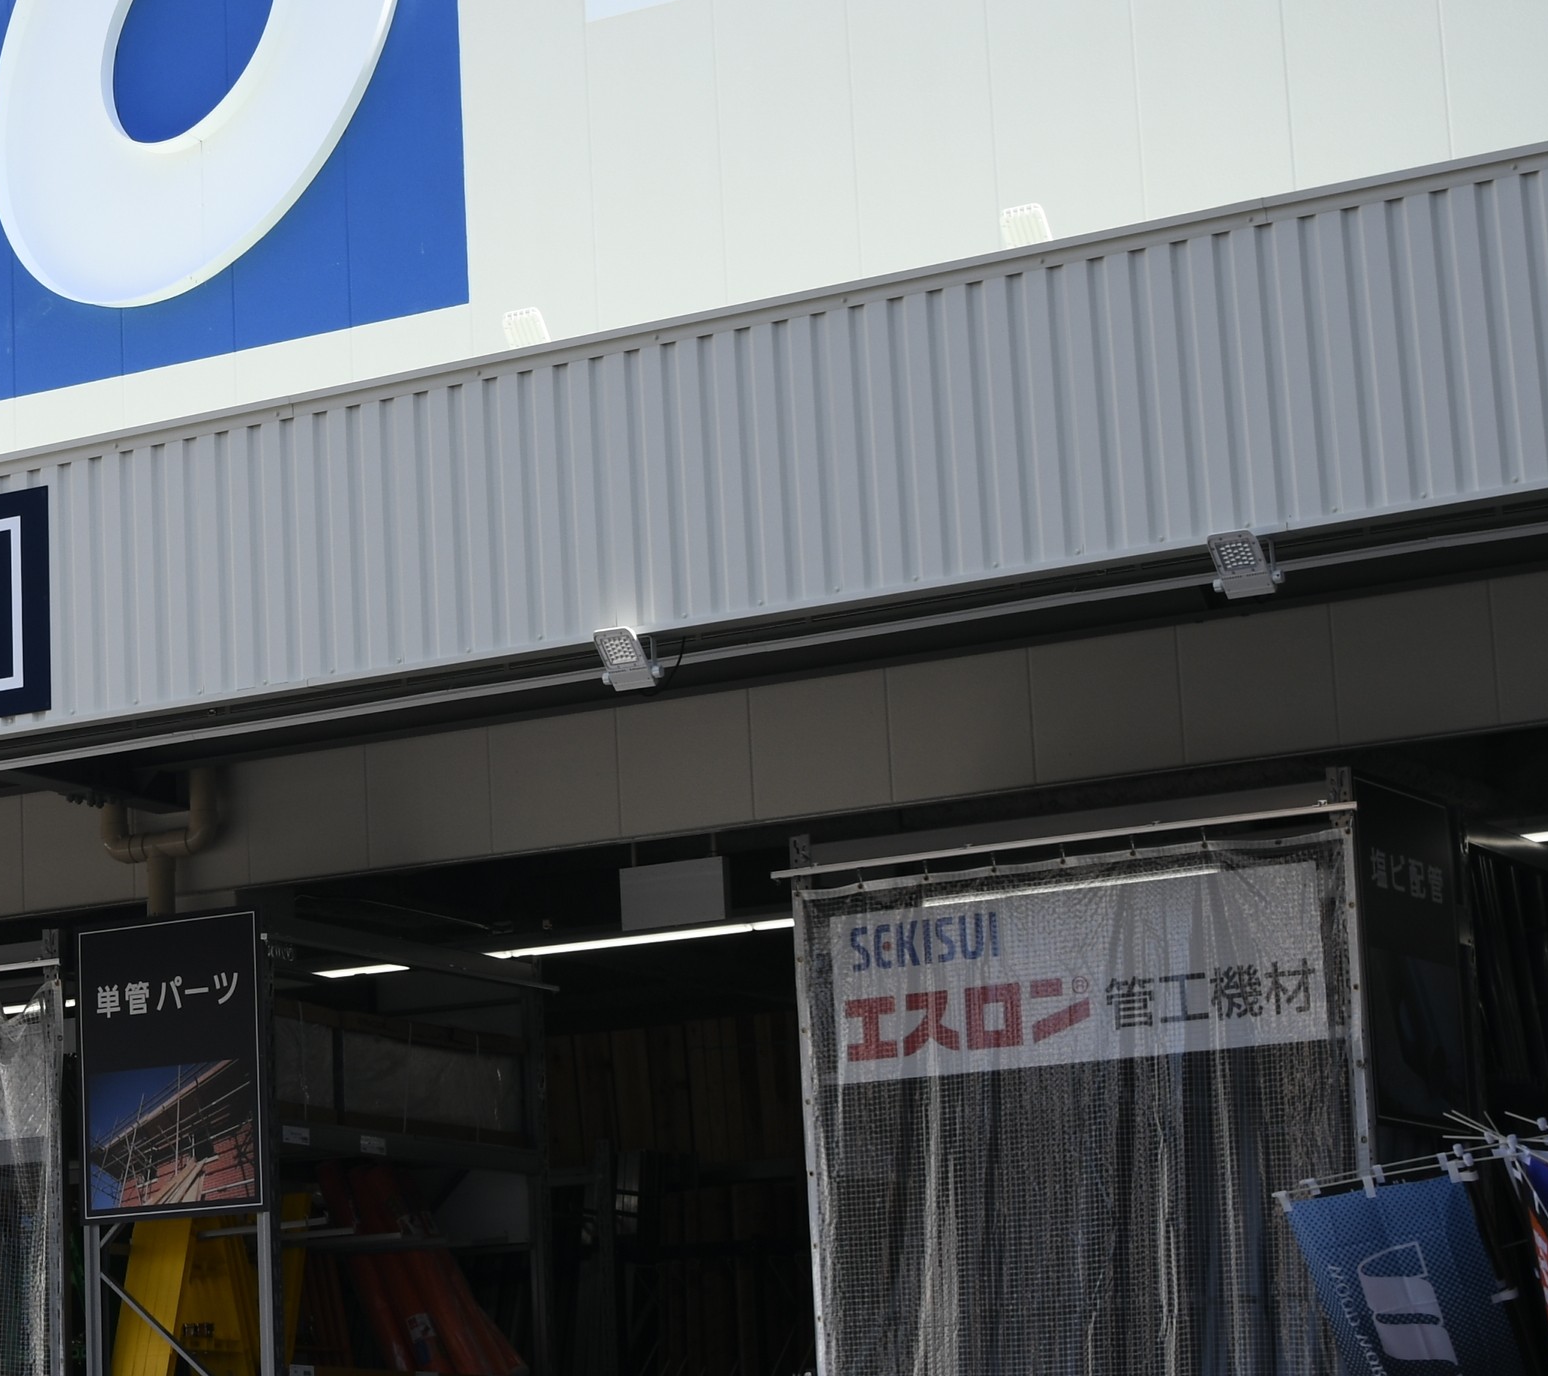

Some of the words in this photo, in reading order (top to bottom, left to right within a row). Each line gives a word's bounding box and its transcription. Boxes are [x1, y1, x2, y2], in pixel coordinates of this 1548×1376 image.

[850, 912, 1000, 973] SEKISUI
[97, 972, 238, 1018] 単管パーツ
[844, 978, 1091, 1062] エスロン
[1105, 958, 1315, 1030] 管工機材
